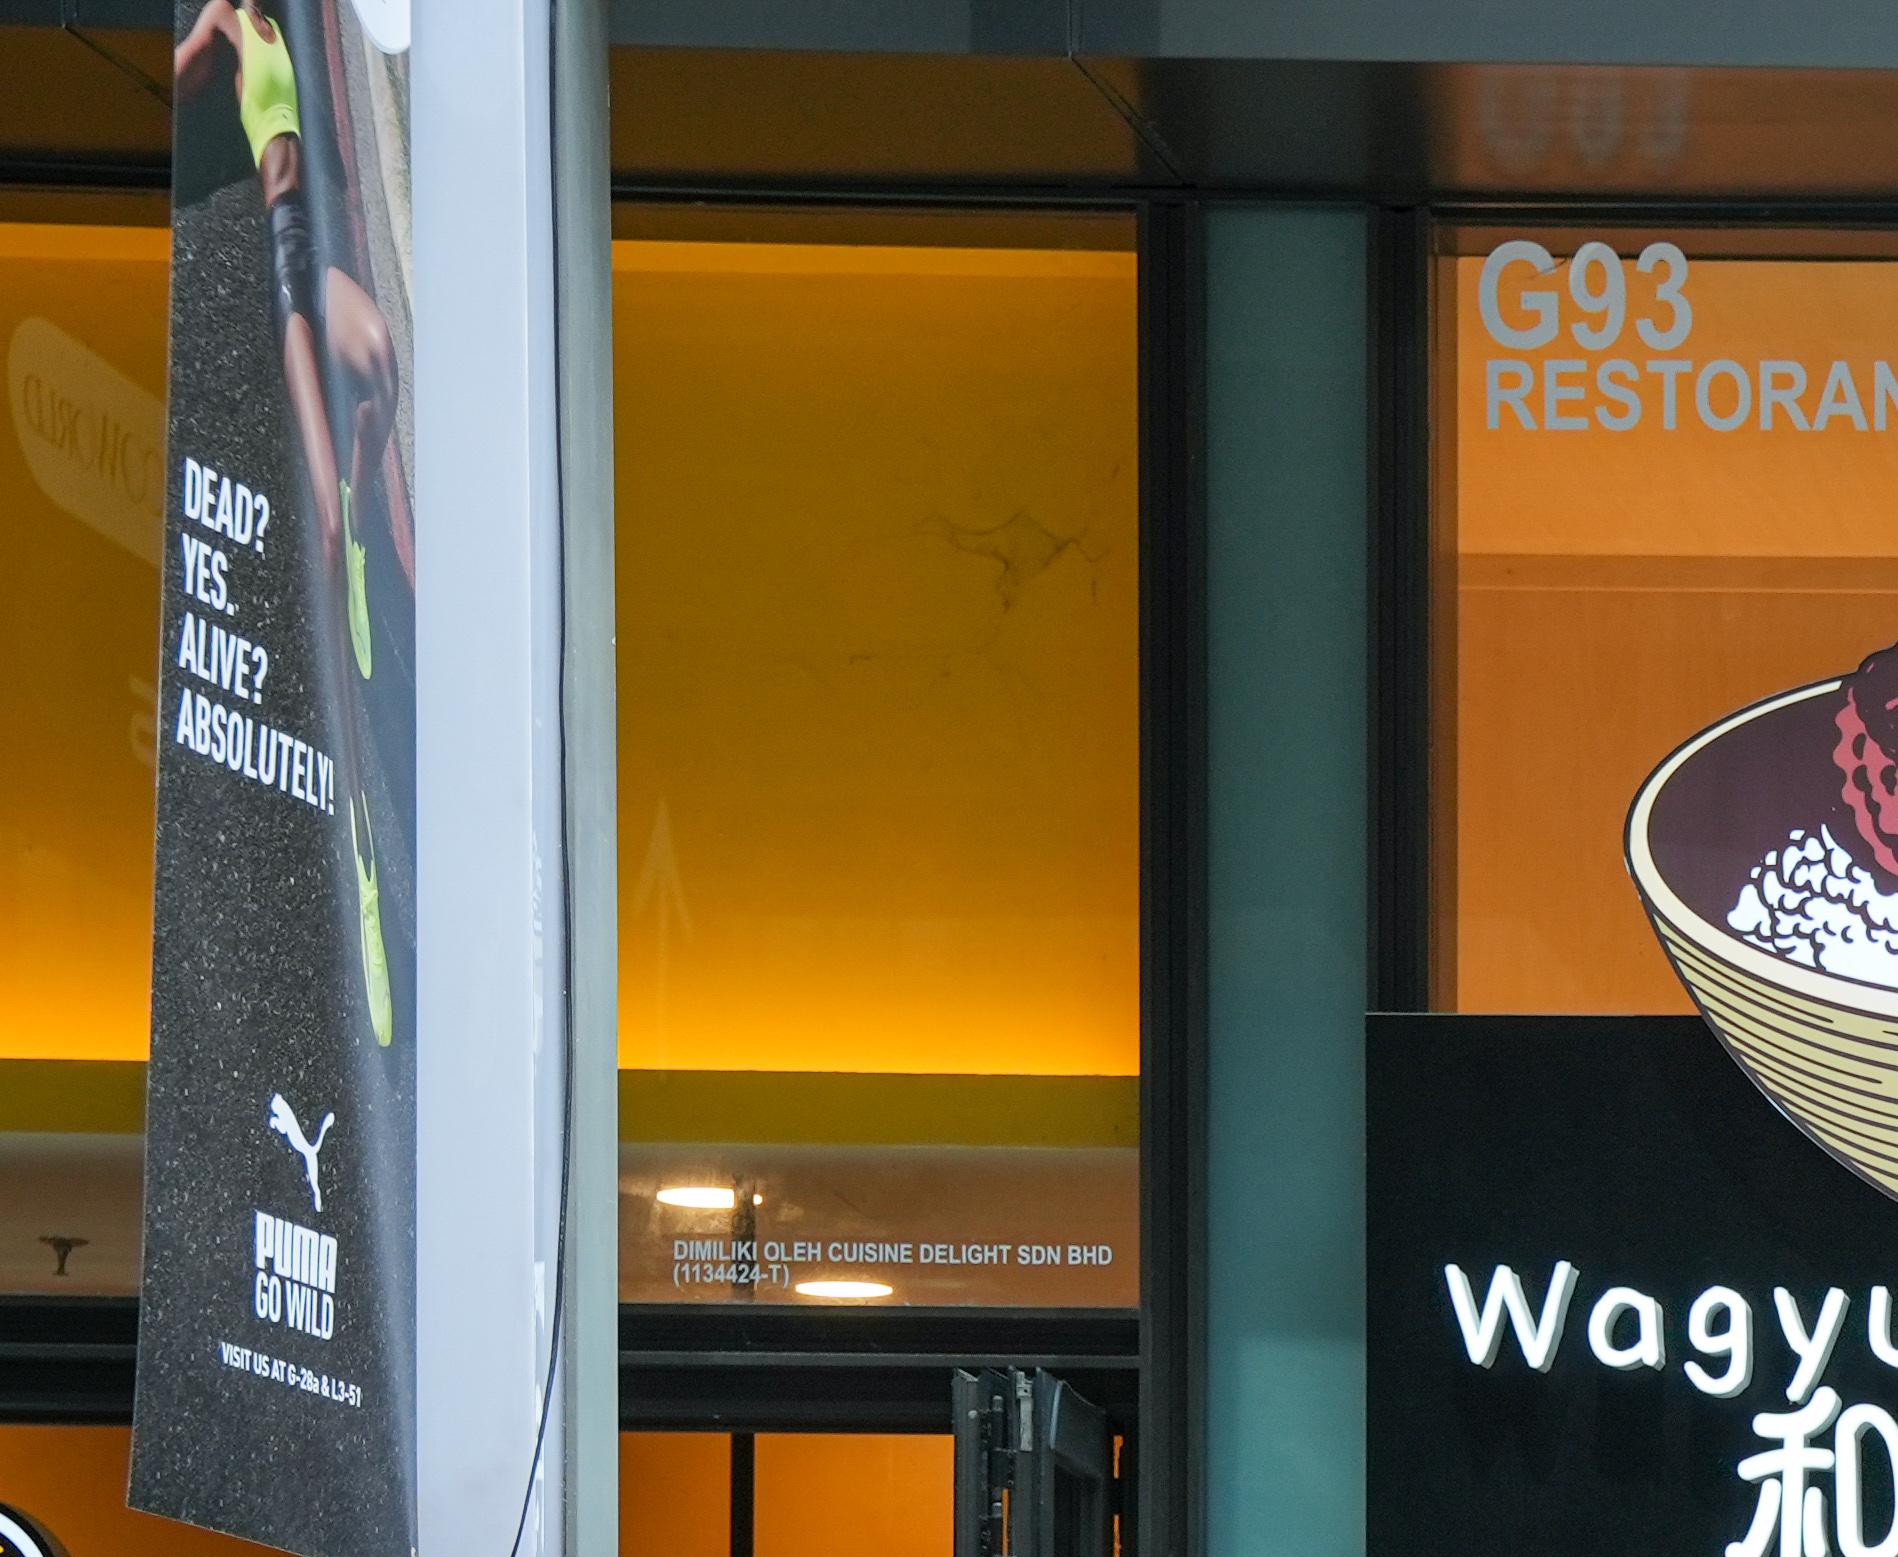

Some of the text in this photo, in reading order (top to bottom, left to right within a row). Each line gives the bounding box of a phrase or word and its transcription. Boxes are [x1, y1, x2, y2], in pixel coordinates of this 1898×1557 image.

[1478, 240, 1693, 350] G93
[185, 456, 270, 553] DEAD?
[181, 533, 237, 617] YES.
[179, 612, 268, 706] ALIVE?
[177, 687, 335, 816] ABSOLUTELY!
[255, 1209, 338, 1293] PUMA
[673, 1263, 791, 1287] (1134424-T)
[674, 1240, 1112, 1266] DIMILIKI OLEH CUISINE DELIGHT SDN BHD
[256, 1271, 335, 1341] GO WILD
[222, 1341, 362, 1408] VISIT US AT G-28a & L3-51
